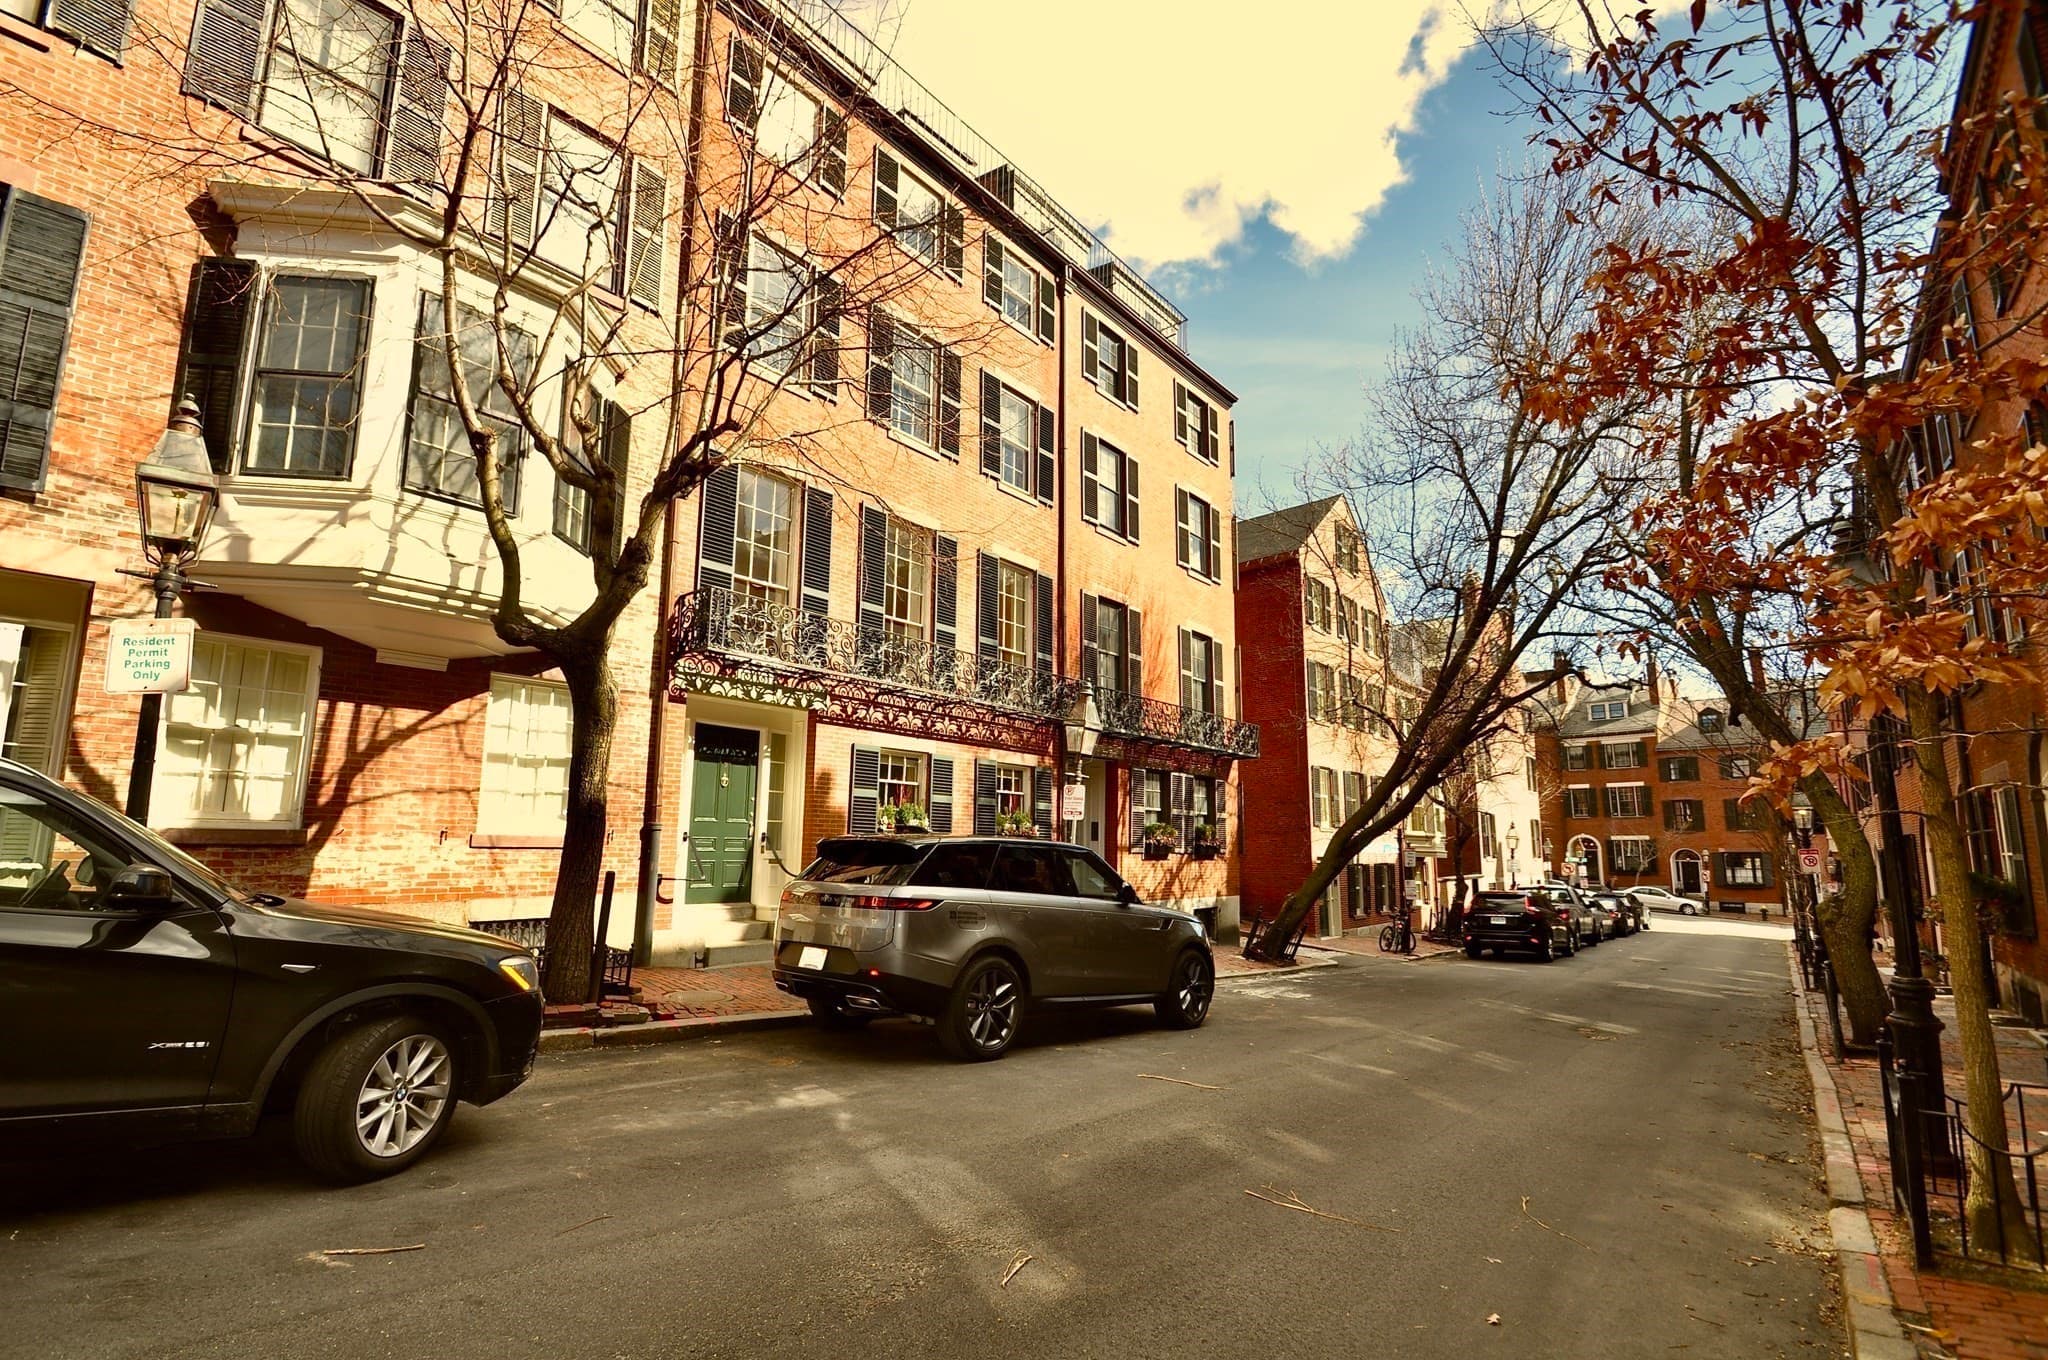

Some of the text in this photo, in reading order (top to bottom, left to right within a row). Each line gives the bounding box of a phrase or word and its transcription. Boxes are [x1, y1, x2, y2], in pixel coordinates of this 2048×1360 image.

[122, 637, 176, 646] Resident
[128, 648, 168, 657] Permit
[124, 660, 171, 669] Parking
[133, 671, 160, 681] Only
